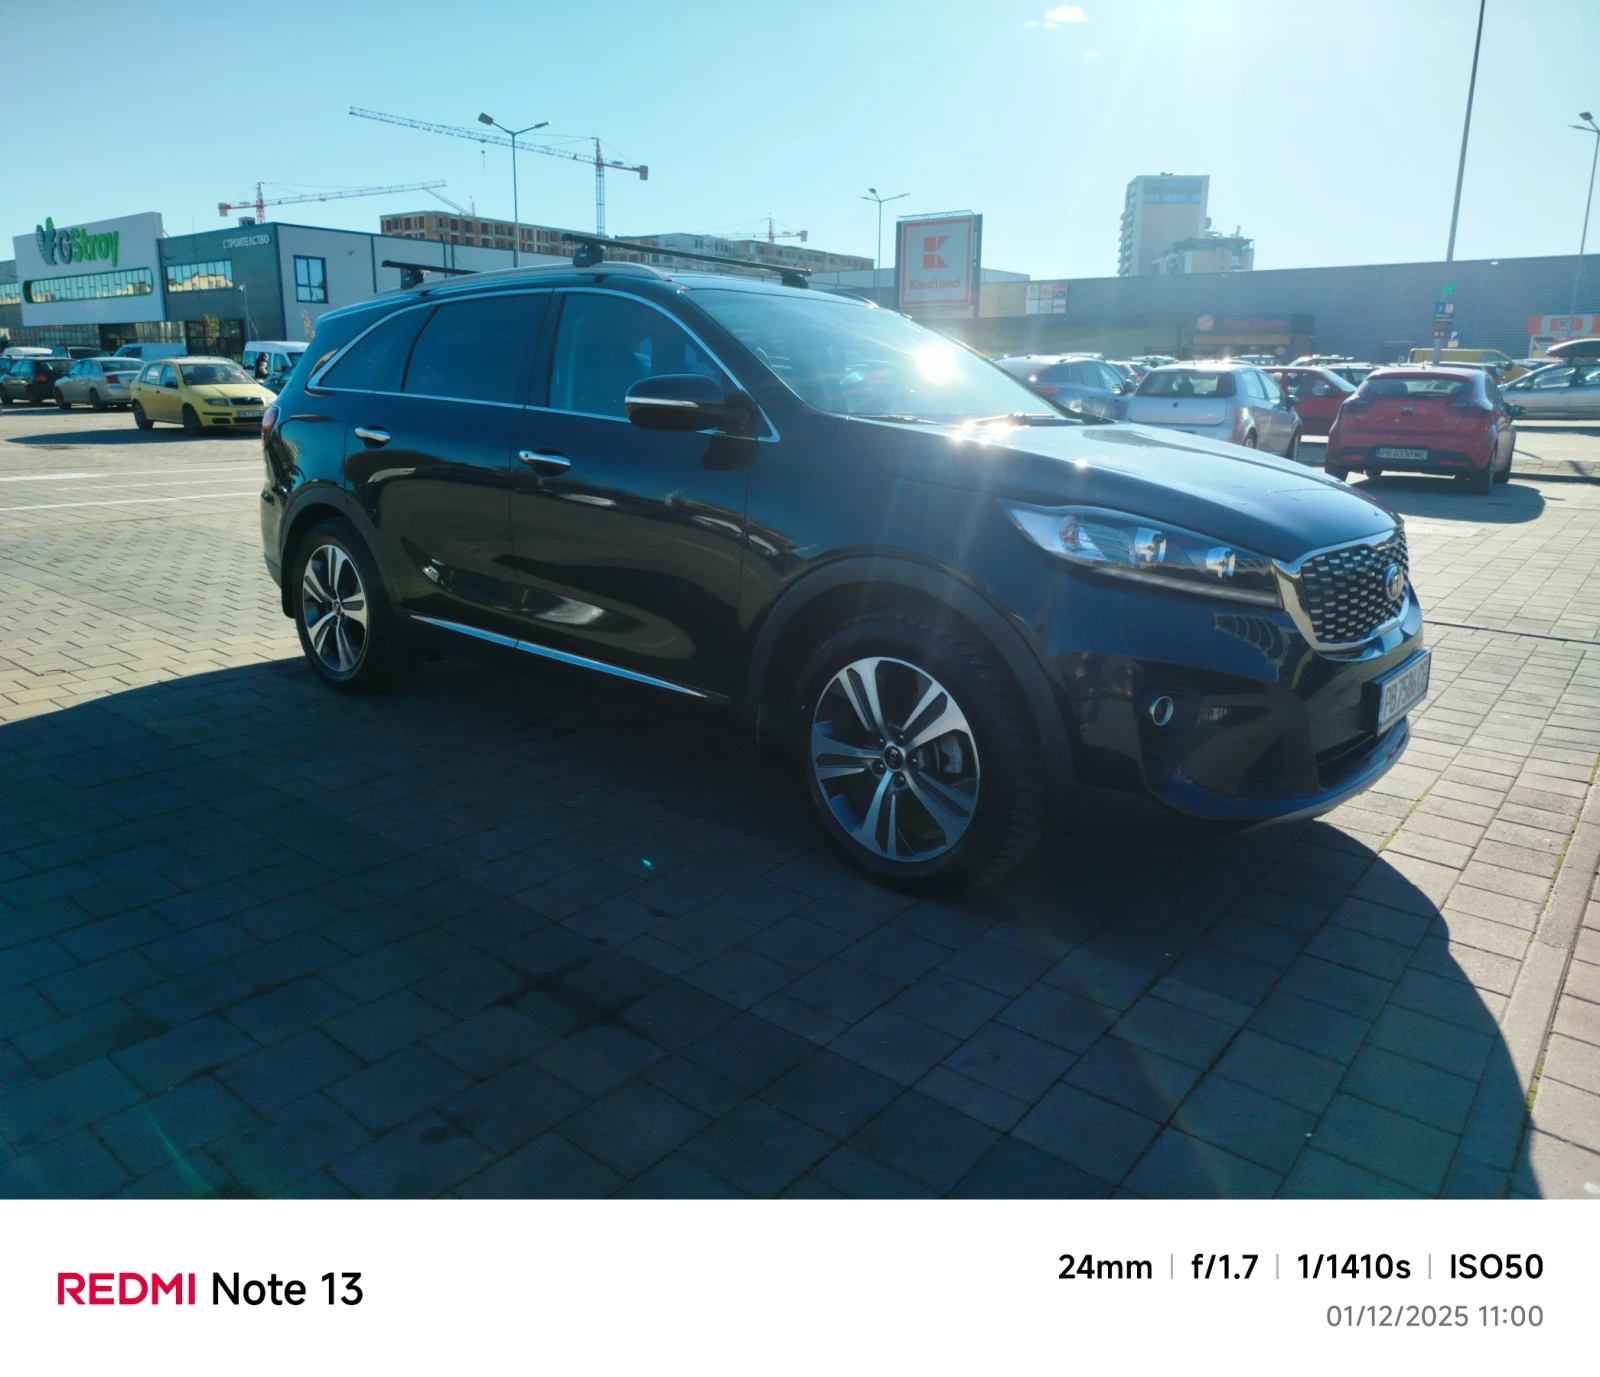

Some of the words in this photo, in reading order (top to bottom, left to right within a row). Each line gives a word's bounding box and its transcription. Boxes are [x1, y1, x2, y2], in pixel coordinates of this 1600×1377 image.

[222, 234, 270, 249] СТРОИТЕЛСТВО
[909, 277, 961, 290] Kaufland
[1384, 684, 1397, 718] PB
